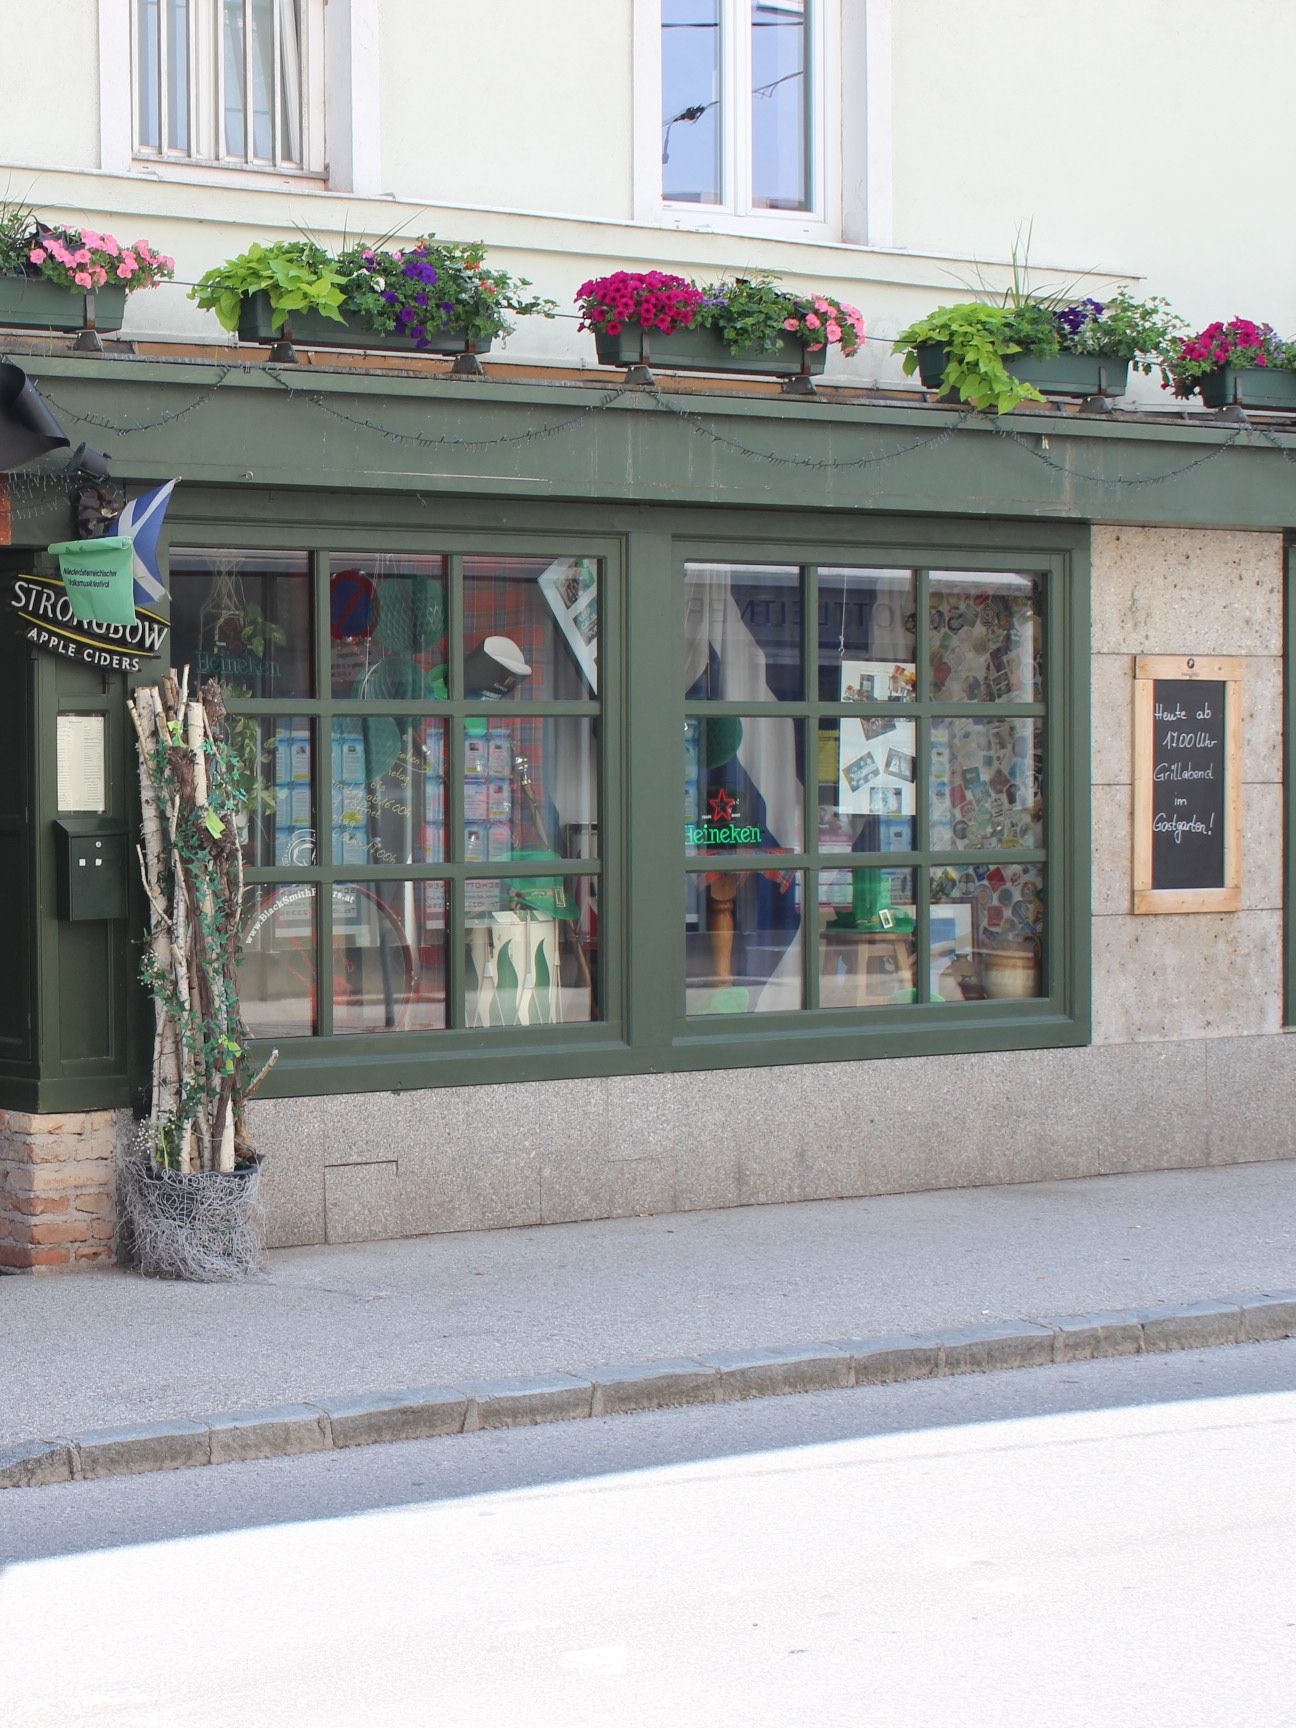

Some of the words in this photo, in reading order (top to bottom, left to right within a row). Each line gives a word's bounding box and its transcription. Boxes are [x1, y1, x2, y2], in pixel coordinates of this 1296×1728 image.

[27, 627, 76, 657] APPLE
[83, 648, 140, 671] CIDERS
[1154, 702, 1187, 721] Heute
[1196, 701, 1212, 720] ab
[1196, 731, 1218, 748] Uhr
[1153, 761, 1214, 782] Grillabend
[1174, 791, 1188, 806] im
[1152, 812, 1215, 844] Gastgarten!
